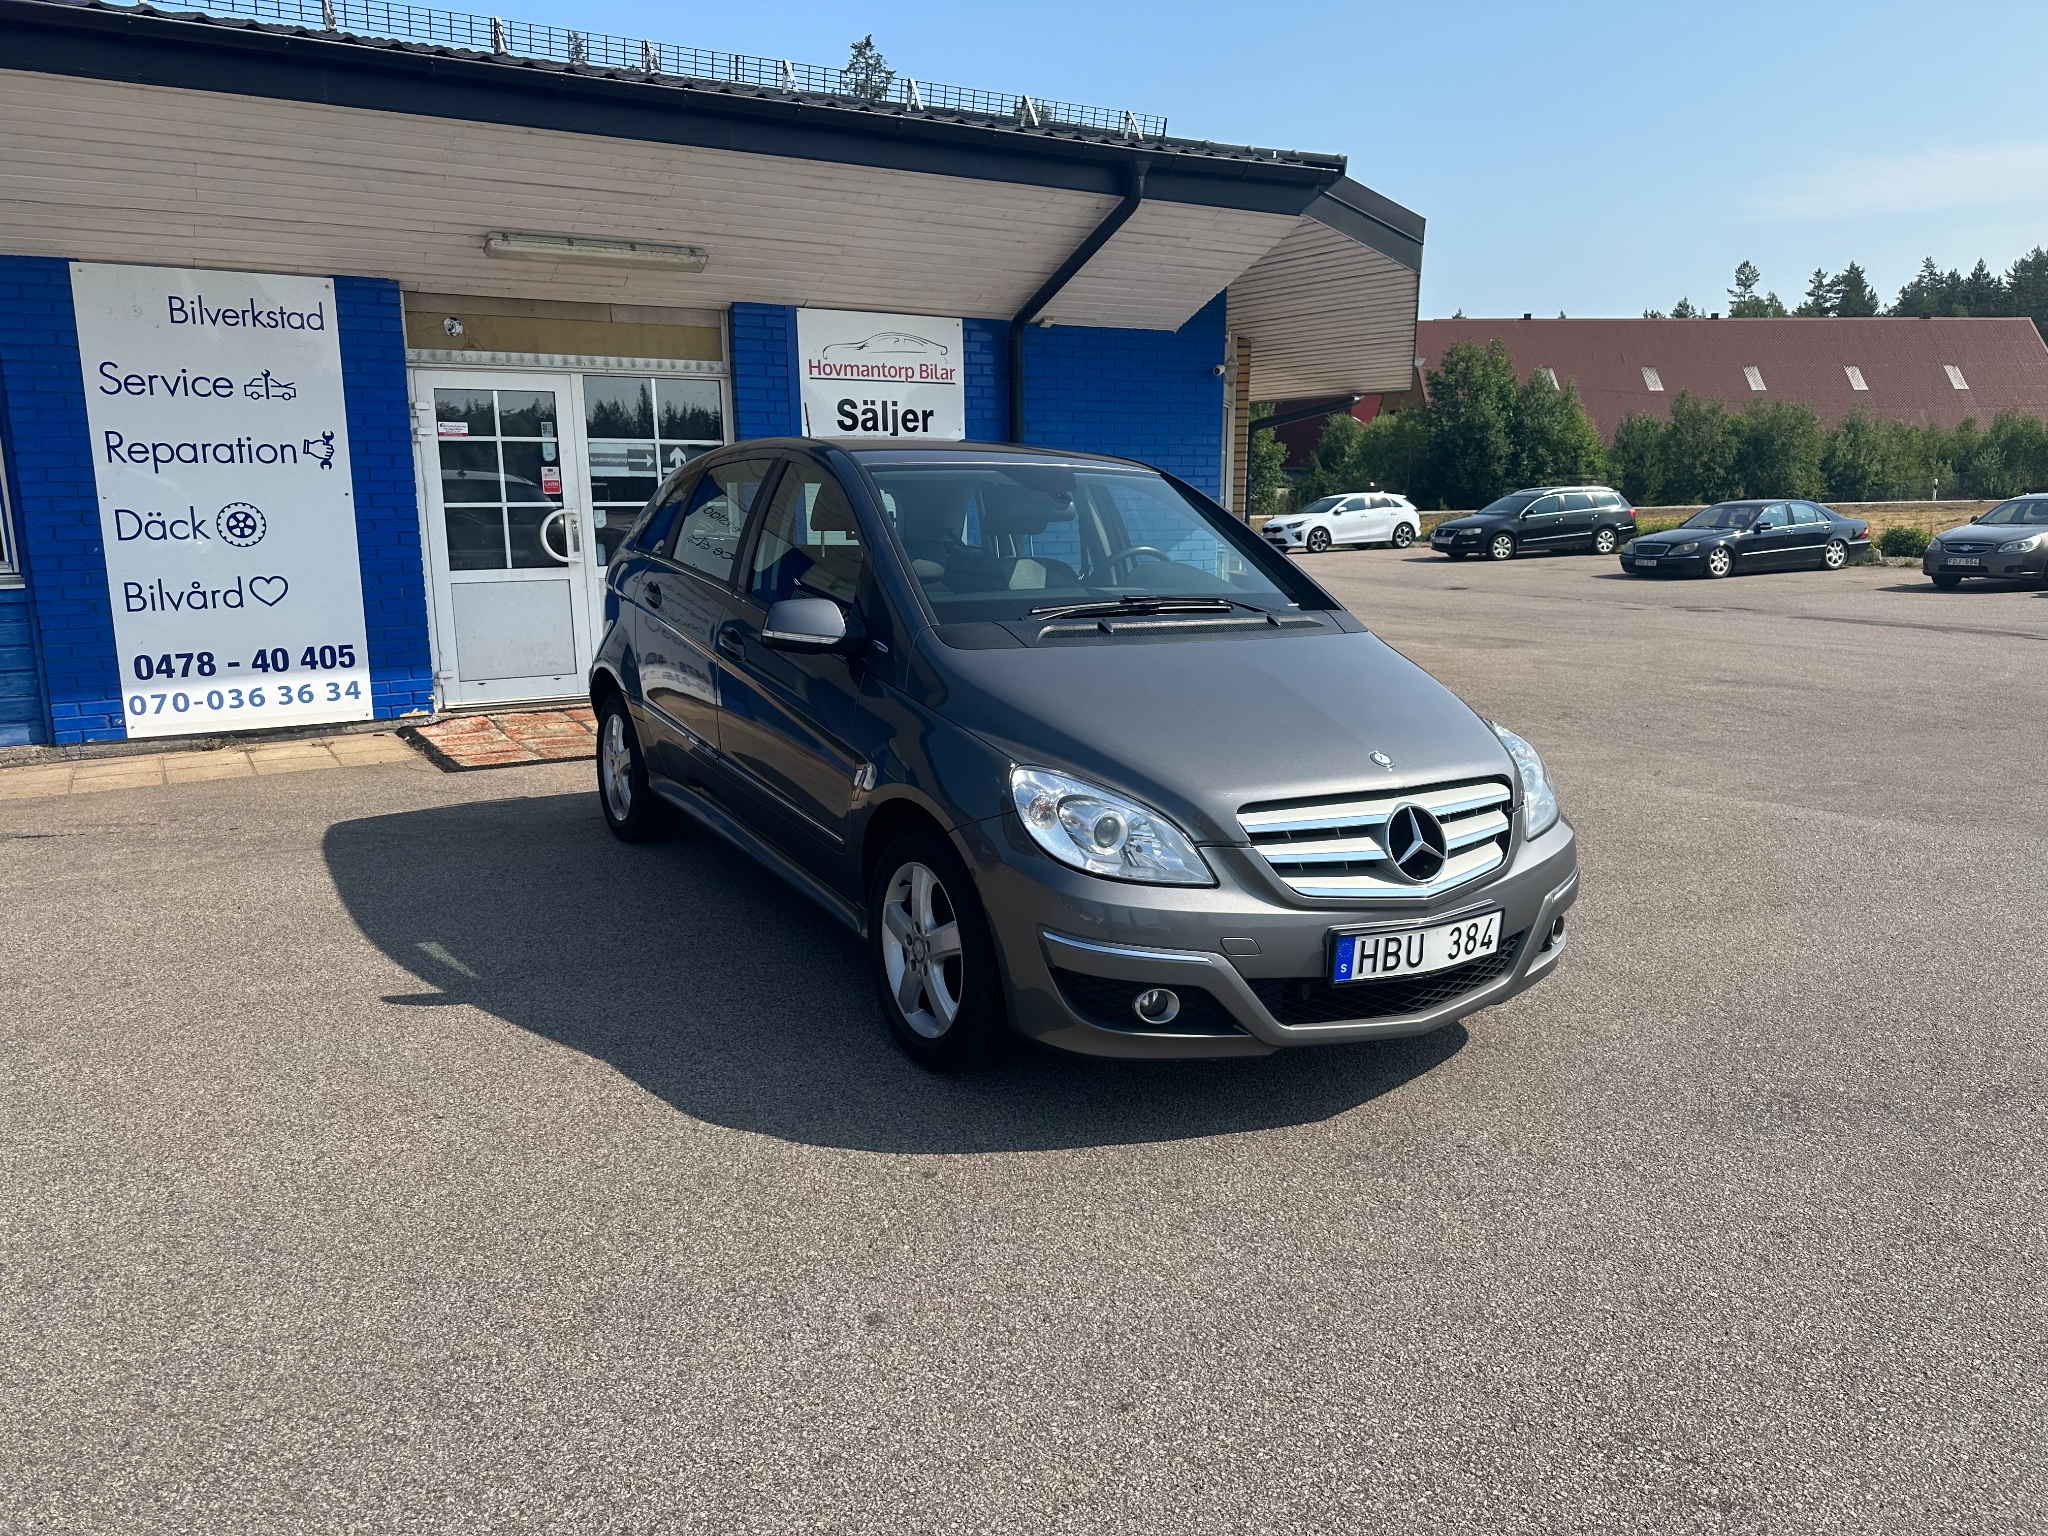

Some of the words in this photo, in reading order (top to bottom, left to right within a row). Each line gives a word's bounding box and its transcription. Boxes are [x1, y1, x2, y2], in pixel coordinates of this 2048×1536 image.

[167, 294, 325, 331] Bilverkstad
[98, 361, 234, 398] Service
[808, 358, 915, 383] Hovmantorp
[919, 363, 956, 381] Bilar
[836, 398, 935, 437] Säljer
[104, 430, 298, 474] Reparation
[114, 505, 212, 541] Däck
[123, 575, 245, 613] Bilvård
[133, 651, 216, 681] 0478
[227, 659, 241, 668] -
[251, 647, 290, 674] 40
[300, 644, 356, 671] 405
[128, 686, 266, 716] 070-036
[278, 683, 315, 706] 36
[326, 680, 362, 701] 34
[1340, 963, 1348, 973] S
[1358, 933, 1425, 974] HBU
[1448, 917, 1494, 961] 384
